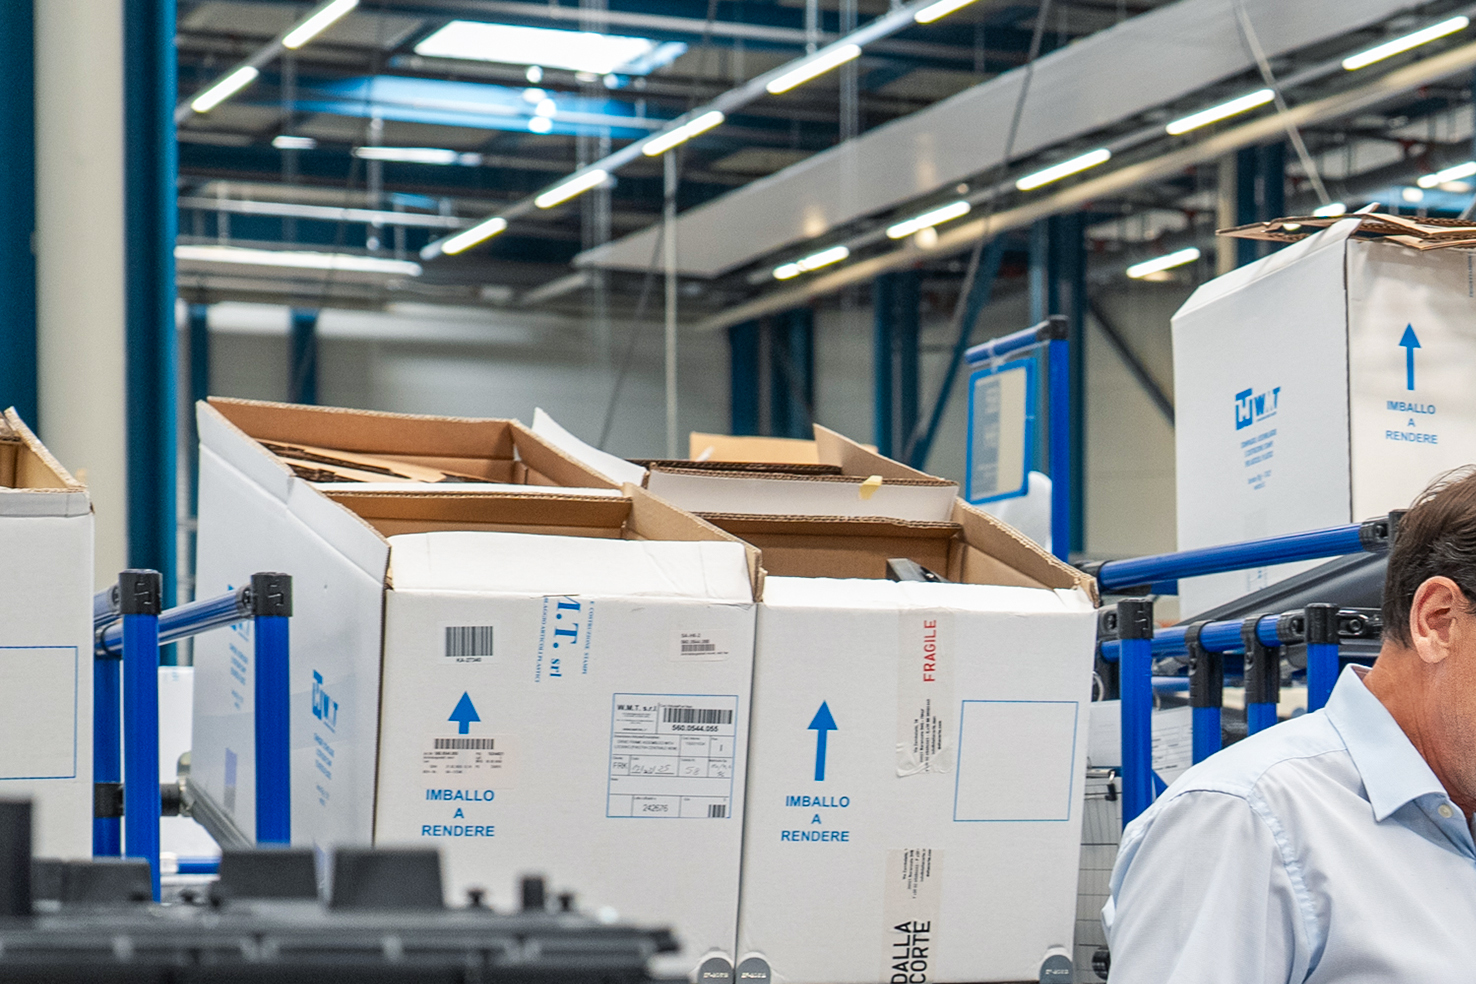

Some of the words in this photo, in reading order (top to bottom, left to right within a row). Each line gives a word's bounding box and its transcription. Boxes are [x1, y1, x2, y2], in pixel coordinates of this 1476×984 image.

[1386, 400, 1436, 415] IMBALLO
[1407, 418, 1416, 428] A
[1385, 430, 1438, 444] RENDERE
[923, 620, 937, 682] FRAGILE
[425, 788, 495, 802] IMBALLO
[785, 795, 851, 808] IMBALLO
[453, 807, 465, 819] A
[811, 813, 822, 825] A
[421, 825, 495, 837] RENDERE
[780, 830, 850, 843] RENDERE
[890, 921, 912, 984] DALLA
[909, 921, 931, 984] CORTE
